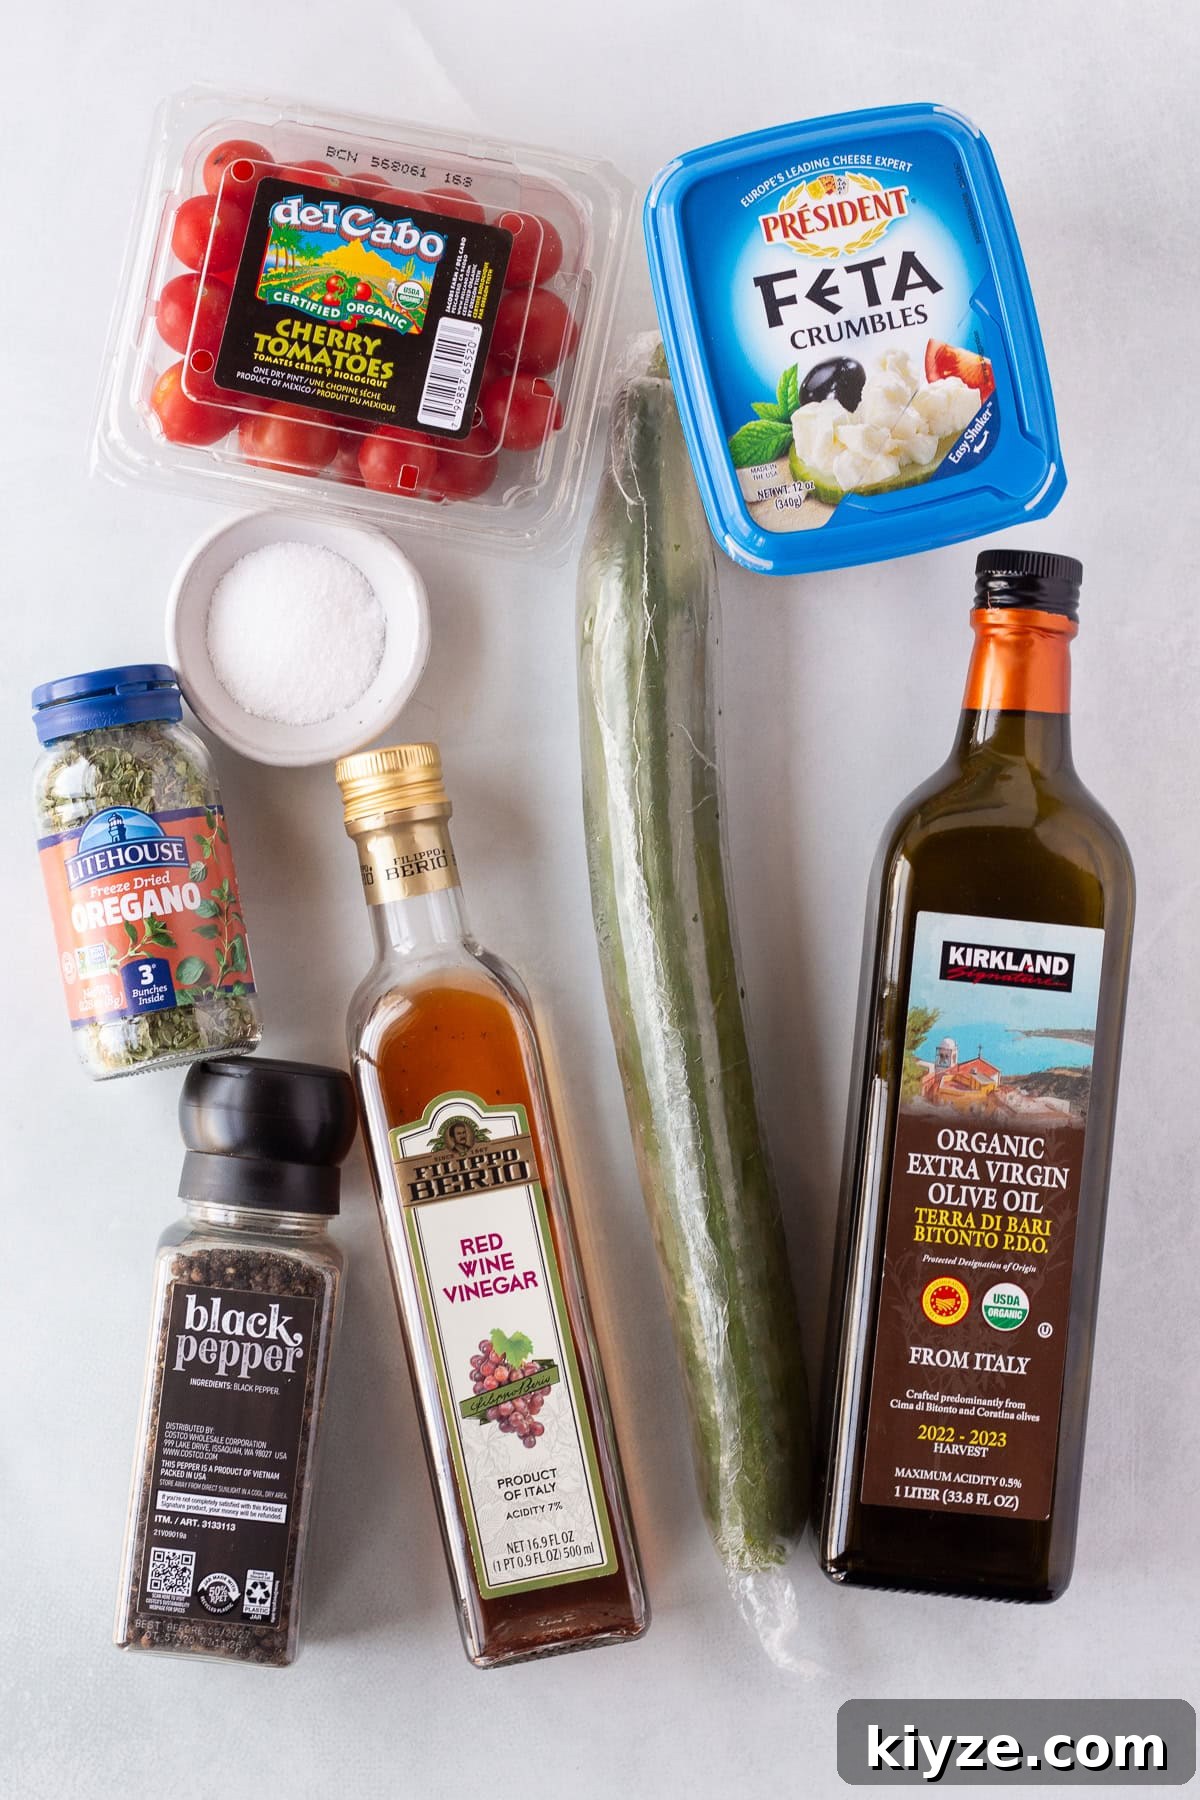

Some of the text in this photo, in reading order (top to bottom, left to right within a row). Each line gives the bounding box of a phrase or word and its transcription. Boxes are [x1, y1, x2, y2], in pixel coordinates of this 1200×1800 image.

[326, 146, 358, 164] BCN
[371, 156, 426, 177] 568061
[740, 155, 912, 208] EUROPE'S LEADING CHEESE EXPERT
[762, 188, 907, 242] PRÉSIDENT
[753, 251, 944, 328] FETA
[273, 292, 408, 329] CERTIFIED ORGANIC
[275, 319, 382, 355] CHERRY
[790, 304, 928, 350] CRUMBLES
[254, 333, 394, 380] TOMATOES
[253, 353, 388, 389] TOMATES CERISE BIOLOGIQUE
[253, 366, 270, 376] ONE
[271, 369, 285, 379] DRY
[326, 382, 359, 395] CHOPINE
[236, 371, 270, 385] PRODUCT
[272, 379, 281, 387] OF
[362, 399, 396, 413] MEXIQUE
[948, 440, 971, 464] Easy
[792, 482, 802, 491] 12
[776, 495, 802, 511] (340g)
[68, 842, 185, 883] LITEHOUSE
[386, 855, 448, 880] BERIO
[393, 848, 440, 865] FILIPPO
[90, 871, 170, 898] Freeze Dried
[71, 882, 201, 932] OREGANO
[949, 946, 1069, 976] KIRKLAND
[132, 984, 168, 998] Bunches
[138, 993, 165, 1005] Inside
[937, 1128, 1045, 1160] ORGANIC
[413, 1148, 520, 1180] FILIPPO
[906, 1153, 1070, 1190] EXTRA VIRGIN
[407, 1161, 530, 1201] BERIO
[928, 1182, 1043, 1214] OLIVE OIL
[915, 1207, 1052, 1237] TERRA DI BARI
[459, 1232, 505, 1256] RED
[913, 1225, 1049, 1255] BITONTO P.D.O.
[457, 1252, 515, 1278] WINE
[922, 1254, 1036, 1274] Protected Designation of Origin
[443, 1270, 539, 1304] VINEGAR
[993, 1293, 1020, 1307] USDA
[185, 1294, 303, 1347] black
[988, 1308, 1023, 1320] ORGANIC
[172, 1334, 303, 1379] pepper
[908, 1346, 1031, 1375] FROM ITALY
[190, 1378, 280, 1395] INGREDIENTS: BLACK PEPPER.
[906, 1388, 1026, 1410] Crafted predominantly from
[890, 1399, 1040, 1422] Cima di Bitonto and Coratina olives
[165, 1422, 204, 1433] DISTRIBUTED
[165, 1430, 267, 1449] COSTCO WHOLESALE CORPORATION
[917, 1425, 955, 1442] 2022
[969, 1430, 1008, 1448] 2023
[163, 1448, 218, 1460] WWW.COSTCO.COM
[164, 1439, 174, 1447] 999
[176, 1440, 190, 1449] LAKE
[255, 1450, 272, 1458] 98027
[274, 1452, 287, 1460] USA
[933, 1443, 988, 1458] HARVEST
[161, 1468, 184, 1478] PACKED
[194, 1472, 206, 1480] USA
[162, 1460, 175, 1468] THIS
[176, 1461, 200, 1471] PEPPER
[214, 1466, 242, 1475] PRODUCT
[253, 1470, 280, 1480] VIETNAM
[497, 1468, 557, 1489] PRODUCT
[895, 1467, 1022, 1488] MAXIMUM ACIDITY 0.5%
[504, 1482, 557, 1502] OF ITALY
[894, 1486, 1020, 1511] 1 LITER (33.8 FL OZ)
[154, 1515, 173, 1524] ITM.
[180, 1517, 200, 1528] ART.
[202, 1520, 236, 1531] 3133113
[506, 1501, 563, 1520] ACIDITY 7%
[507, 1530, 575, 1554] NET 16.9 FL OZ
[492, 1542, 595, 1573] (1 PT 0.9 FL OZ) 500 ml
[209, 1585, 228, 1596] 50%
